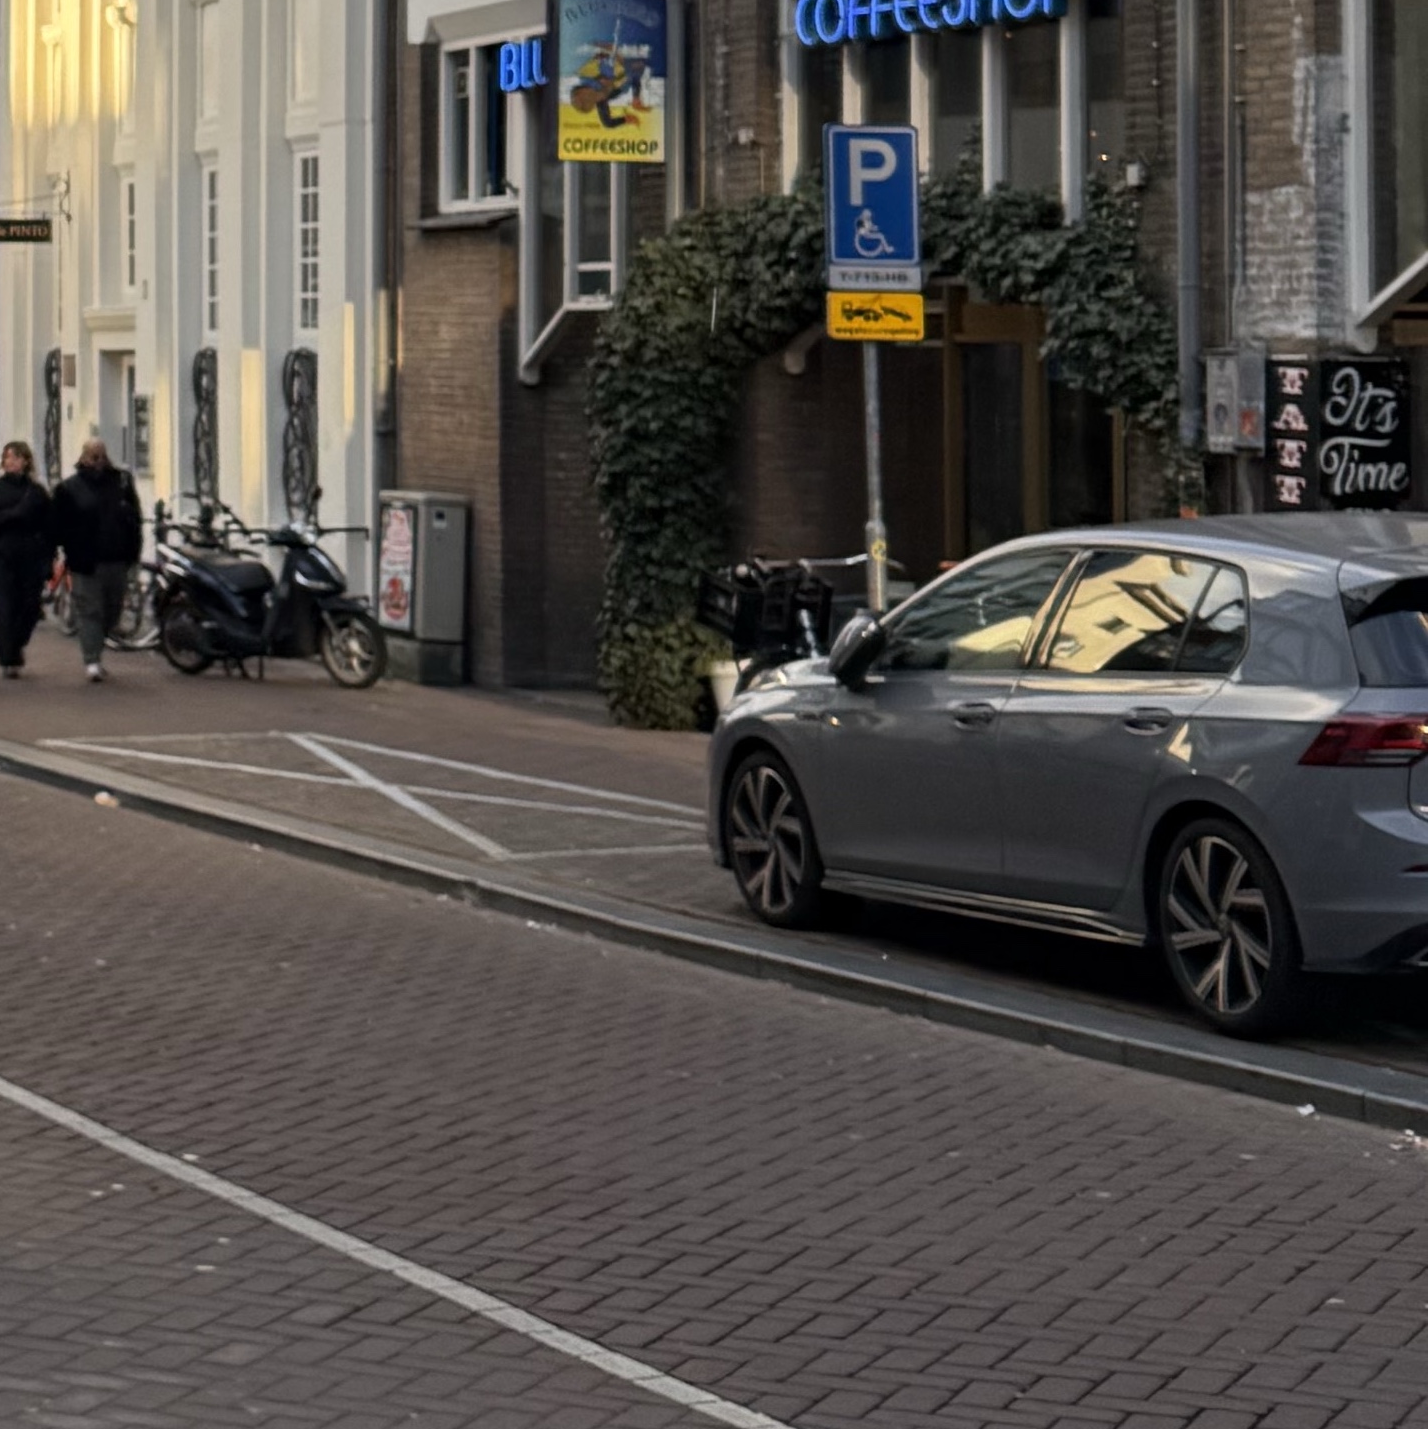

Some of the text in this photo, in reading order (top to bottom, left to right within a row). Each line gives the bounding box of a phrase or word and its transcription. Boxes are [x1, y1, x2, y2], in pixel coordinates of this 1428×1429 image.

[563, 137, 659, 156] COFFEESHOP
[849, 138, 897, 207] P
[1325, 366, 1400, 433] It's
[1320, 435, 1409, 496] Time
